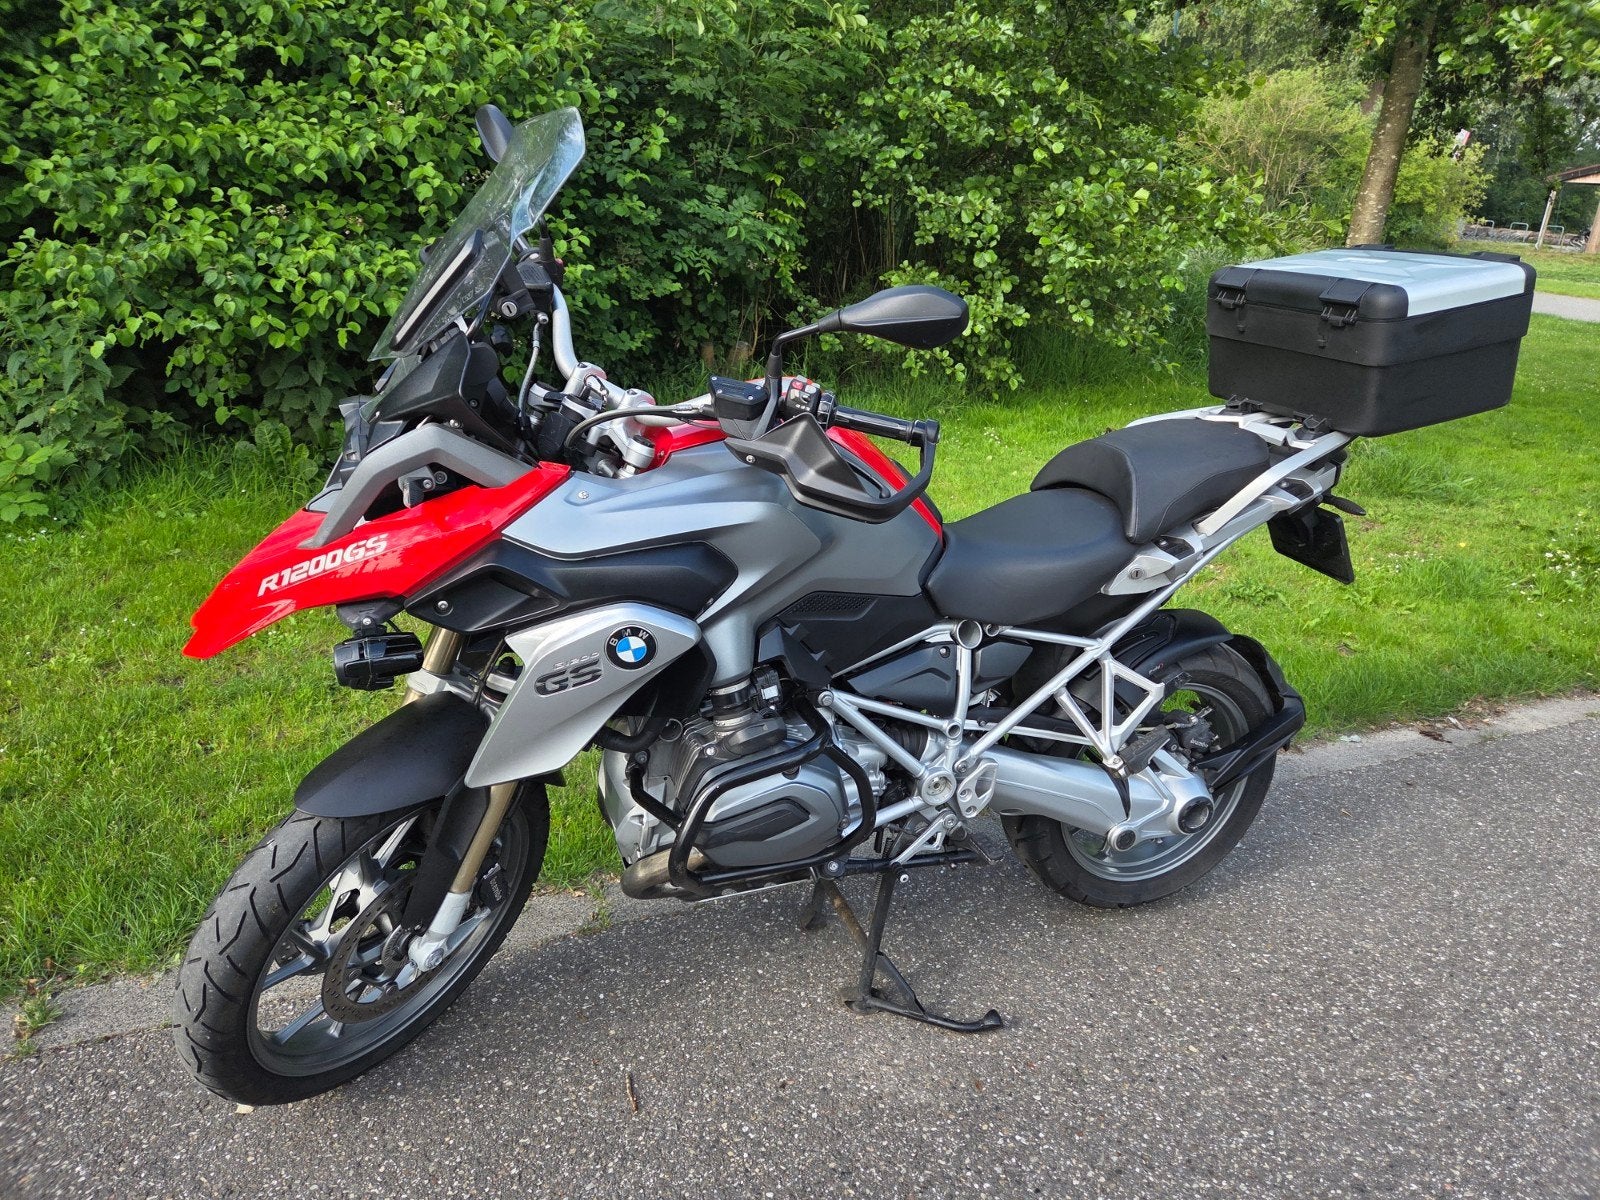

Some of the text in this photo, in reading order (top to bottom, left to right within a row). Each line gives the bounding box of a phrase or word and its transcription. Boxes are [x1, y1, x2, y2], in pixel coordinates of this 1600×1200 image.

[257, 533, 389, 597] R1200GS
[609, 628, 650, 647] BMW
[534, 658, 602, 696] GS
